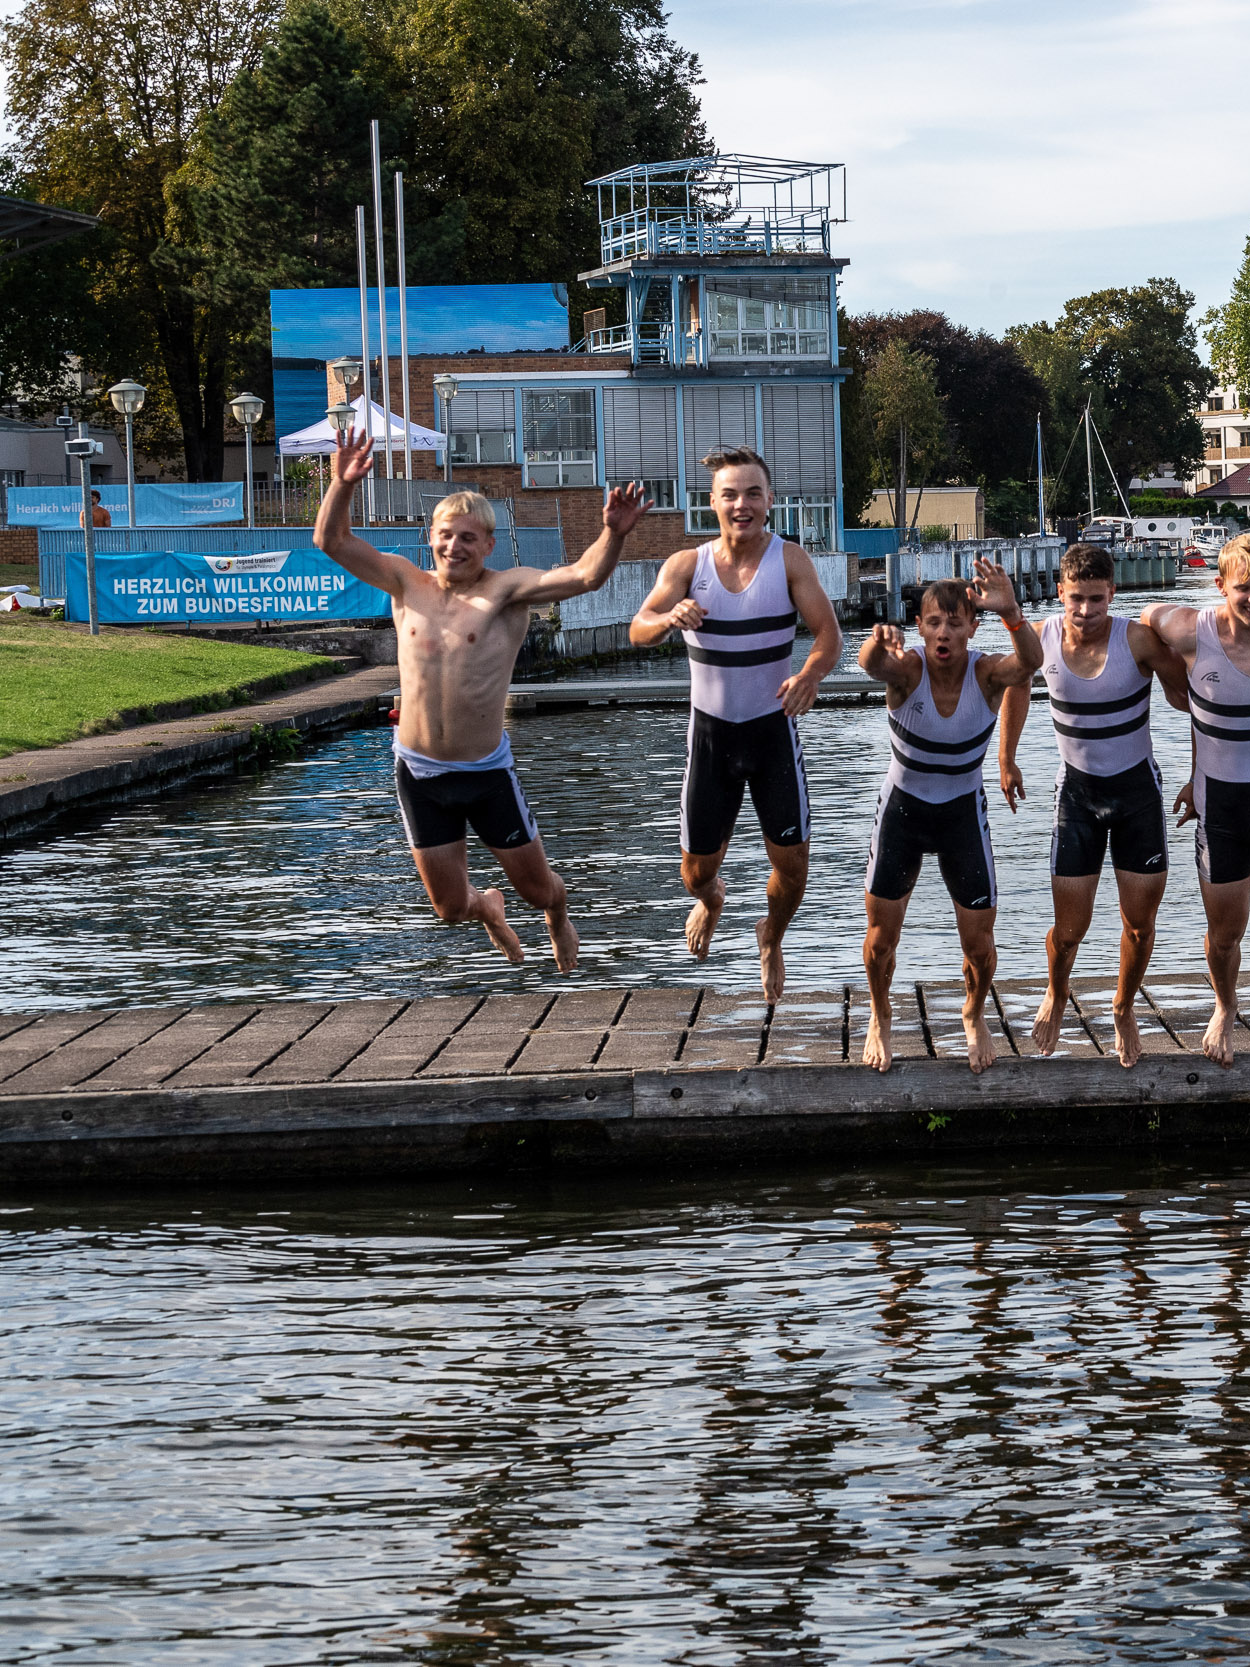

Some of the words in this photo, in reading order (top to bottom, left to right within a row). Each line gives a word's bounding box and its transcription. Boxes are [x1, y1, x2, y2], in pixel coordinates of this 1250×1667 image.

[16, 503, 59, 514] Herzlich
[212, 498, 236, 508] DRJ
[113, 578, 207, 594] HERZLICH
[213, 575, 345, 593] WILLKOMMEN
[137, 598, 178, 614] ZUM
[185, 595, 329, 613] BUNDESFINALE
